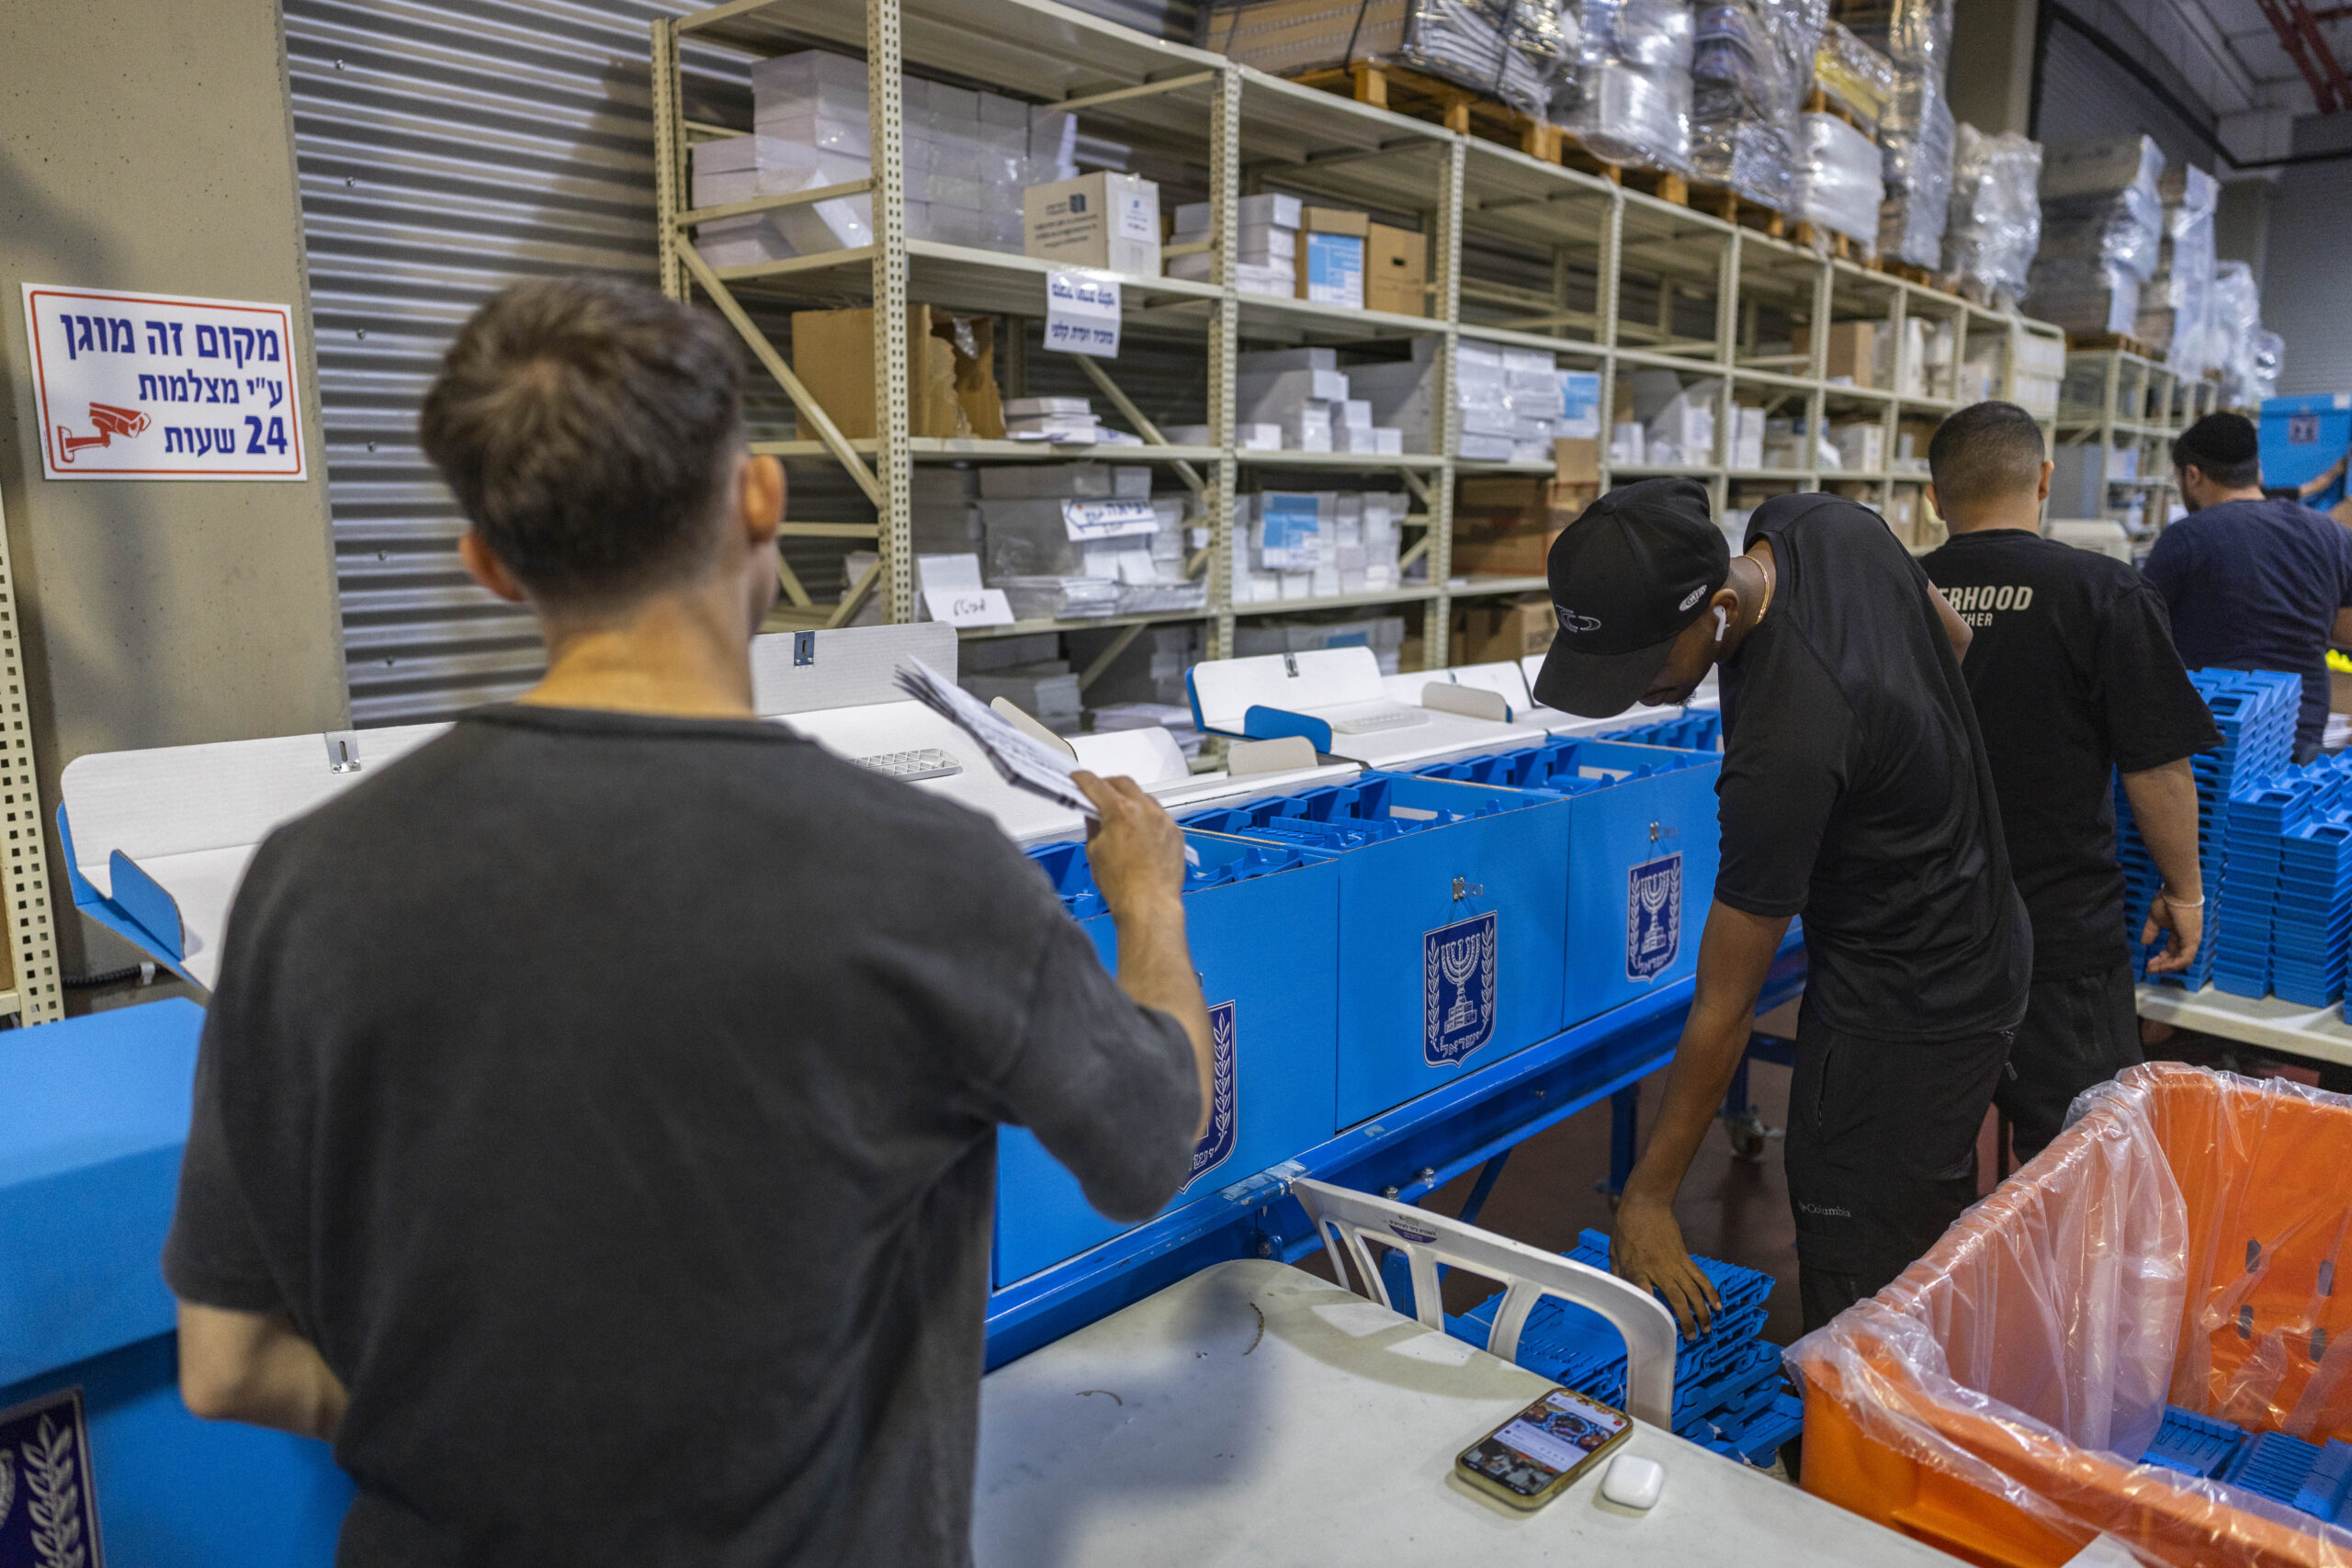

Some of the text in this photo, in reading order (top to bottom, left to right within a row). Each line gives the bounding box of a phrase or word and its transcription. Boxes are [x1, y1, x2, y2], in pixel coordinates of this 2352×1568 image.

[60, 313, 280, 369] מקום זה מוגן
[138, 369, 283, 410] ע"י מצלמות
[164, 415, 288, 457] 24 שעות
[1440, 1031, 1480, 1058] ישראל
[1806, 1203, 1852, 1217] Columbia
